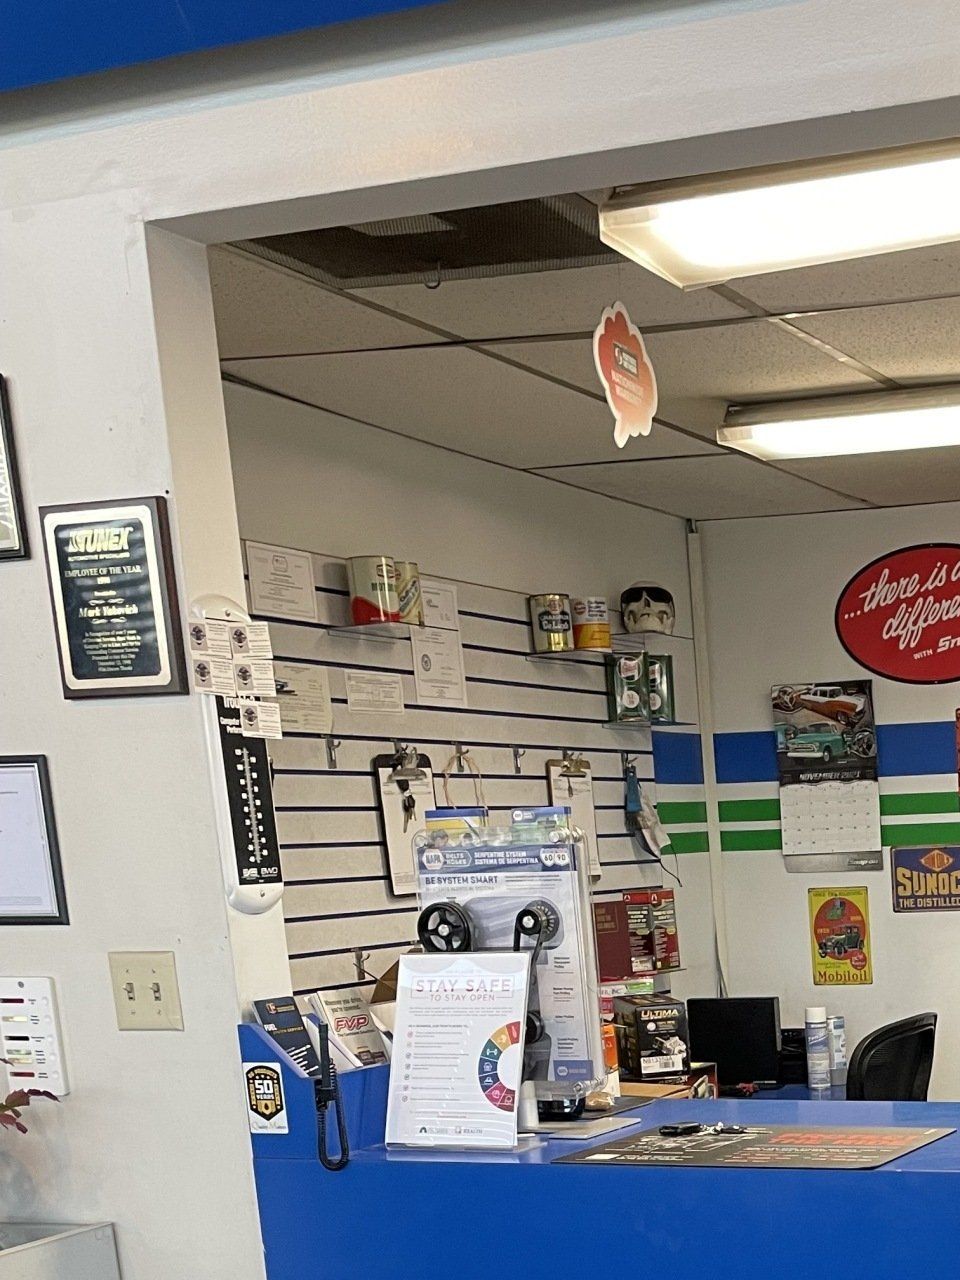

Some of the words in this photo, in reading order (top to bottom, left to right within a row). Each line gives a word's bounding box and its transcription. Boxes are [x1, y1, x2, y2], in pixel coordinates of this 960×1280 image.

[64, 569, 99, 578] EMPLOYEE
[108, 566, 122, 575] THE
[122, 564, 142, 574] YEAR
[912, 649, 934, 661] WITH
[425, 876, 435, 885] BE
[437, 876, 469, 885] SYSTEM
[470, 875, 498, 885] SMART
[899, 898, 916, 908] THE
[817, 970, 868, 983] Mobiloil
[415, 979, 459, 993] STAY
[465, 978, 512, 992] SAFE
[430, 994, 441, 1002] TO
[444, 994, 466, 1002] STAY
[470, 993, 495, 1001] OPEN
[641, 1009, 679, 1018] ULTIMA
[335, 1014, 369, 1033] FVP
[254, 1079, 274, 1094] 50
